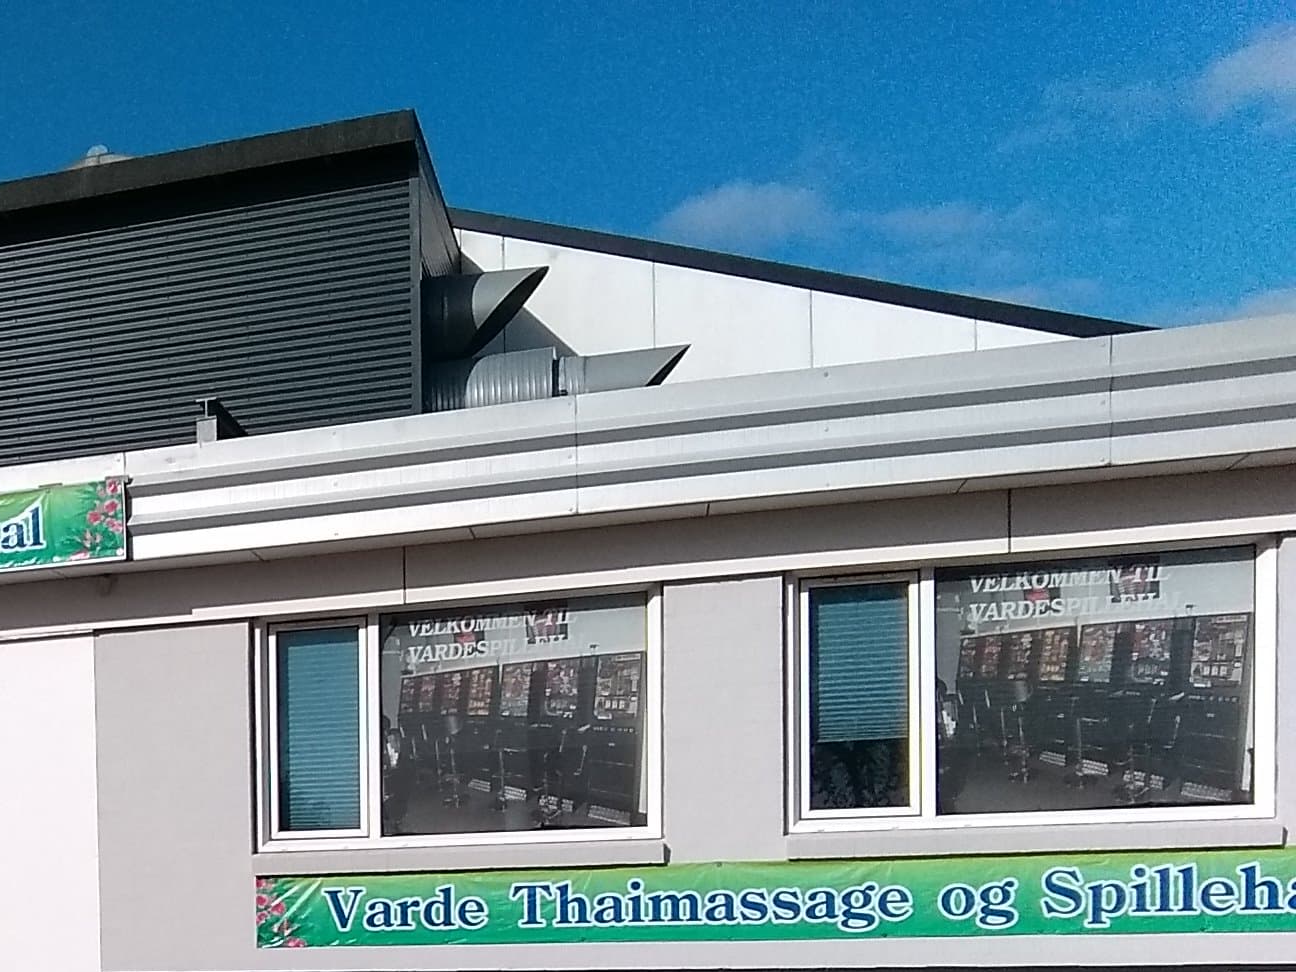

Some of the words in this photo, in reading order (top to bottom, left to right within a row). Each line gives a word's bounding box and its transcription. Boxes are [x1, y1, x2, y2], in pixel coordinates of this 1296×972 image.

[323, 884, 488, 931] Varde
[513, 880, 912, 932] Thaimassage
[939, 879, 1016, 928] og
